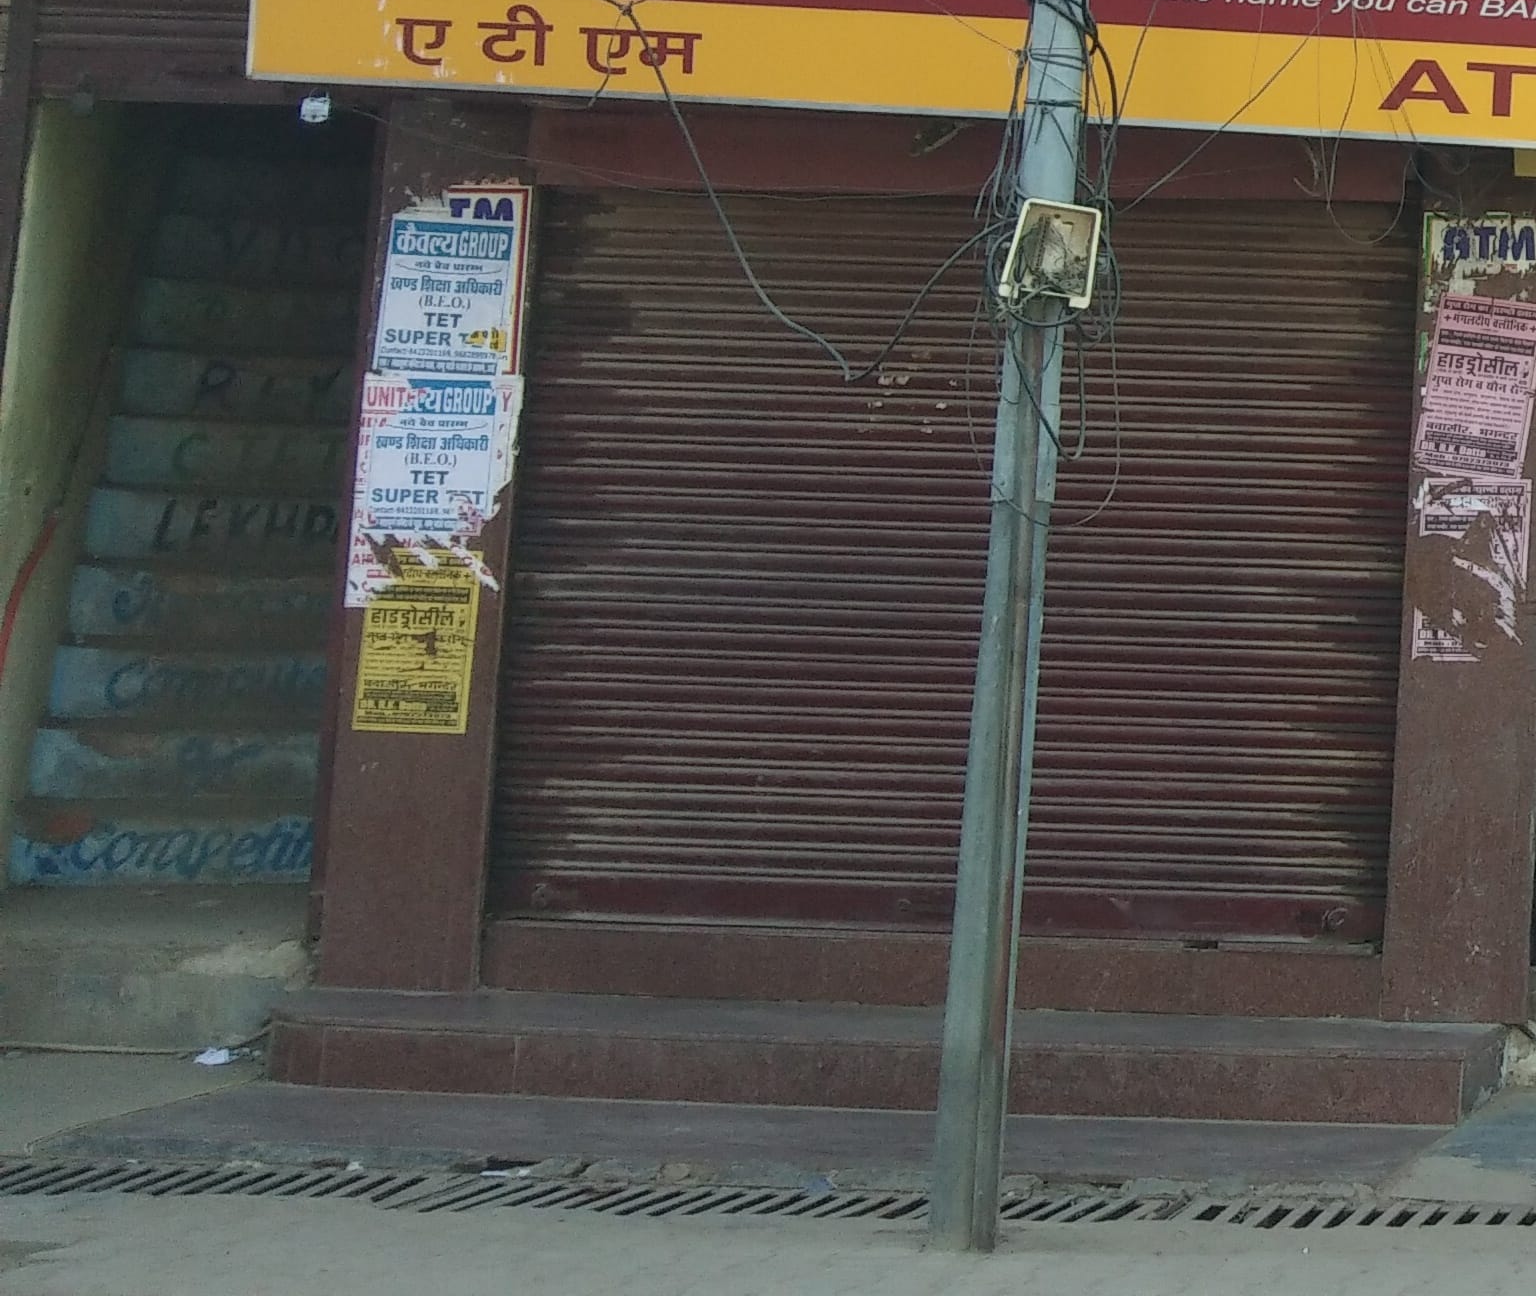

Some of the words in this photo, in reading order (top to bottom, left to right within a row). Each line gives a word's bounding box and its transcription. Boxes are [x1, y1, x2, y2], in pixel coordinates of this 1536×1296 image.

[396, 18, 452, 66] ए
[477, 5, 553, 67] टी
[579, 26, 703, 75] एम
[459, 231, 509, 258] GROUP
[1443, 225, 1536, 261] ATM
[424, 312, 462, 328] TET
[384, 328, 451, 347] SUPER
[444, 387, 493, 414] GROUP
[410, 470, 449, 486] TET
[371, 488, 439, 504] SUPER
